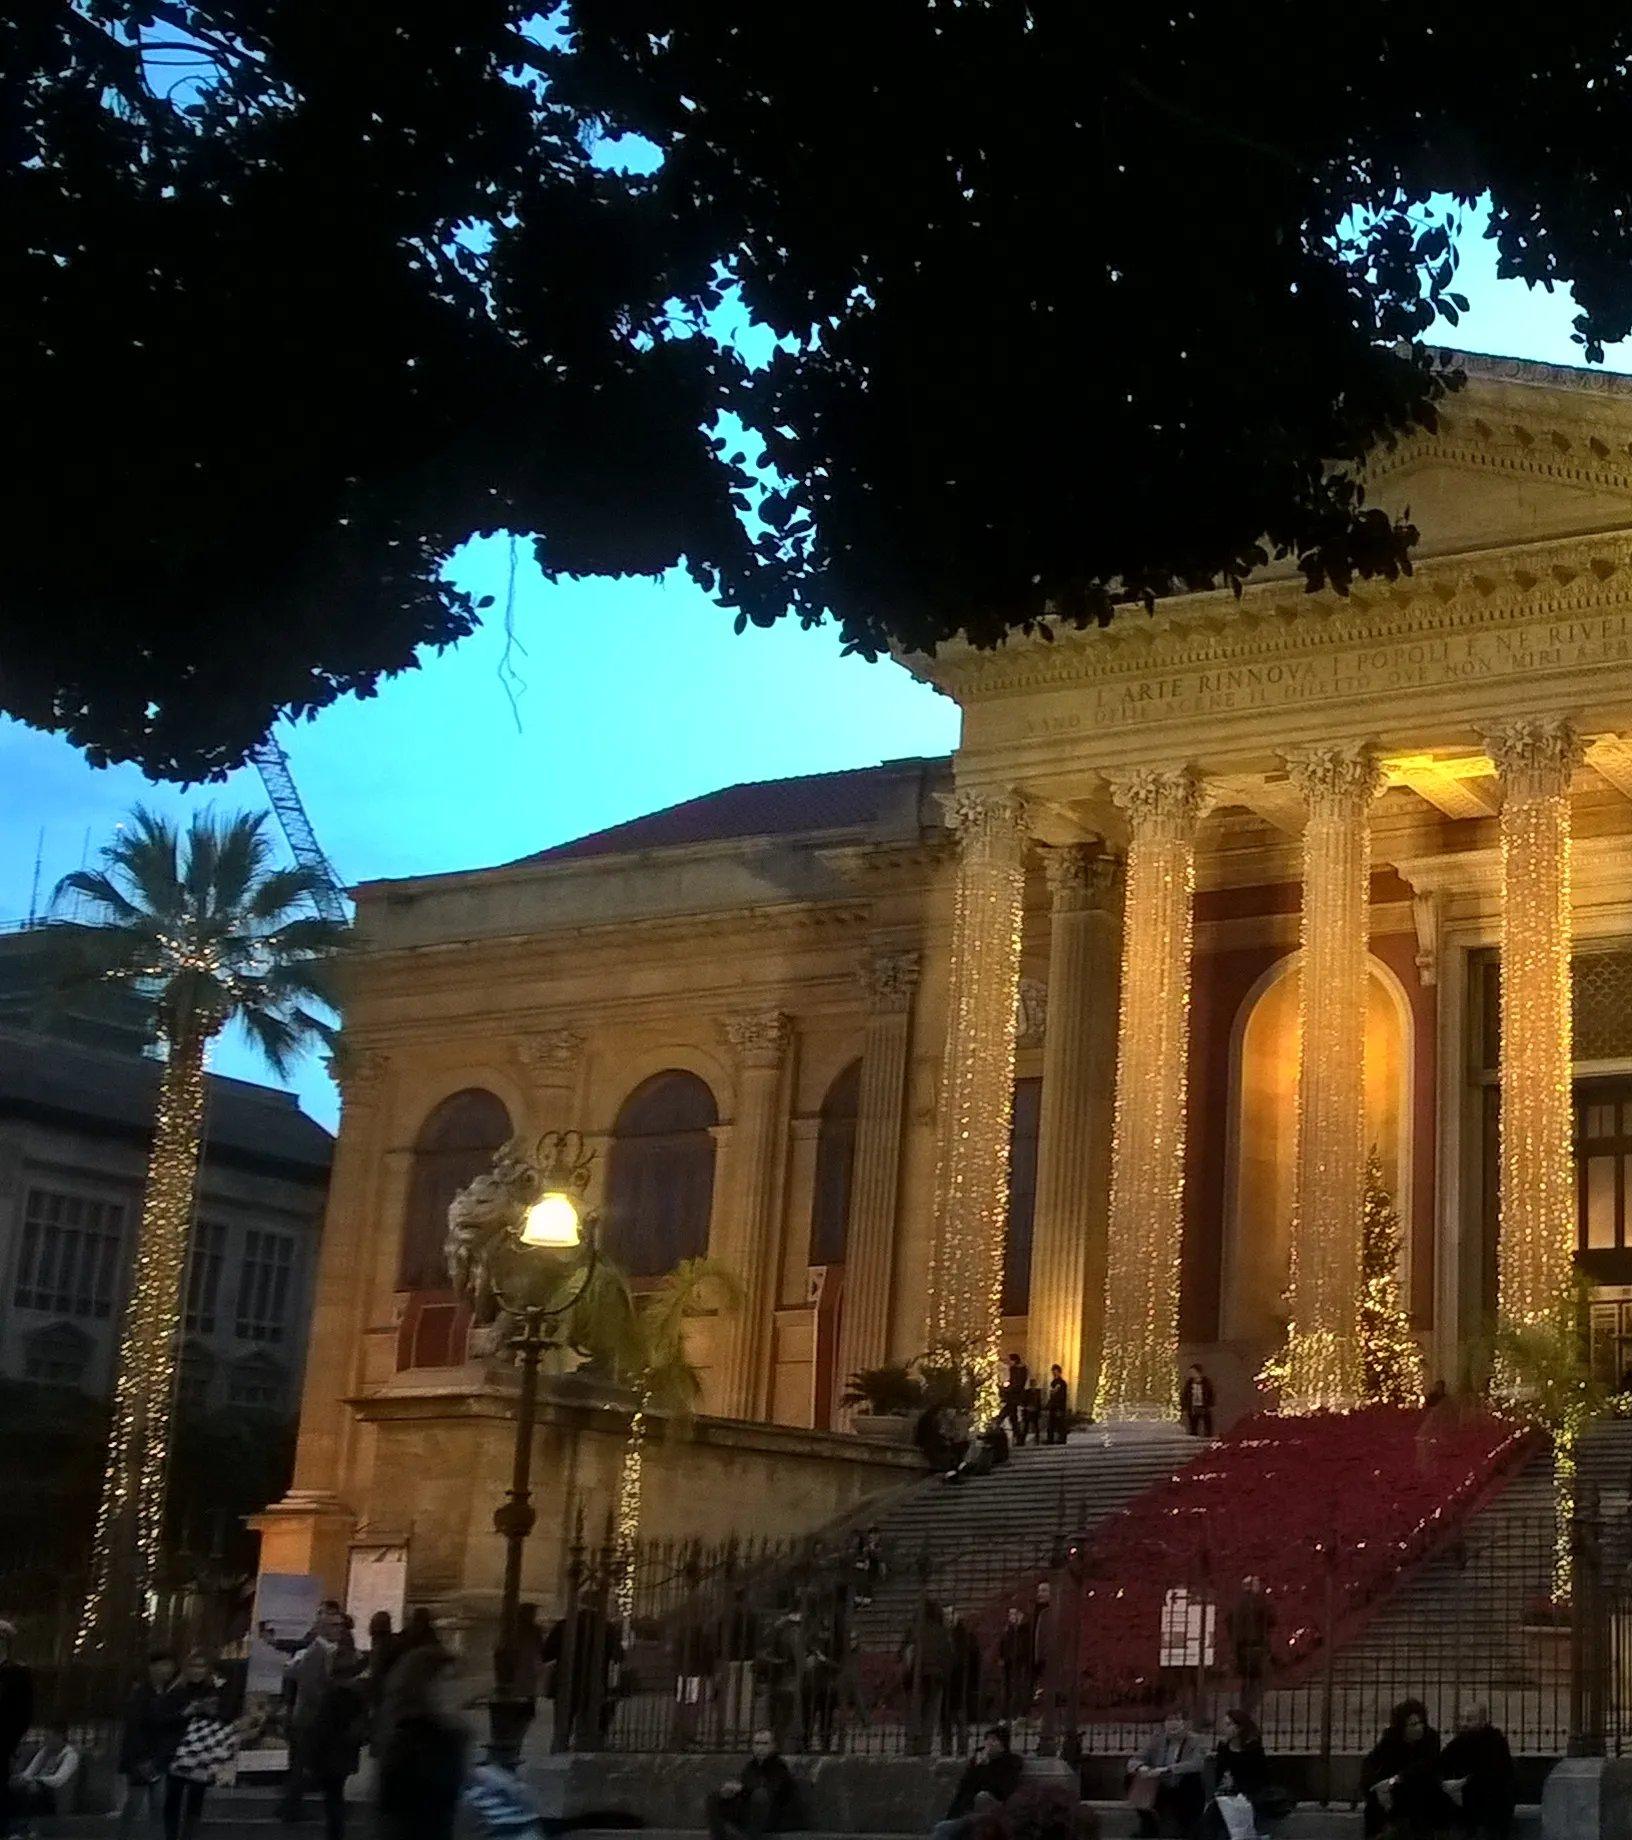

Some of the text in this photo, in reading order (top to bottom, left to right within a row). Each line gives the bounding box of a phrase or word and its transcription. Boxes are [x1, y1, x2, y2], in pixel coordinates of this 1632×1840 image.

[1198, 662, 1317, 695] RINNOVA
[1358, 641, 1449, 672] POPOLI
[1444, 657, 1492, 678] NON
[1511, 648, 1561, 669] MIRI
